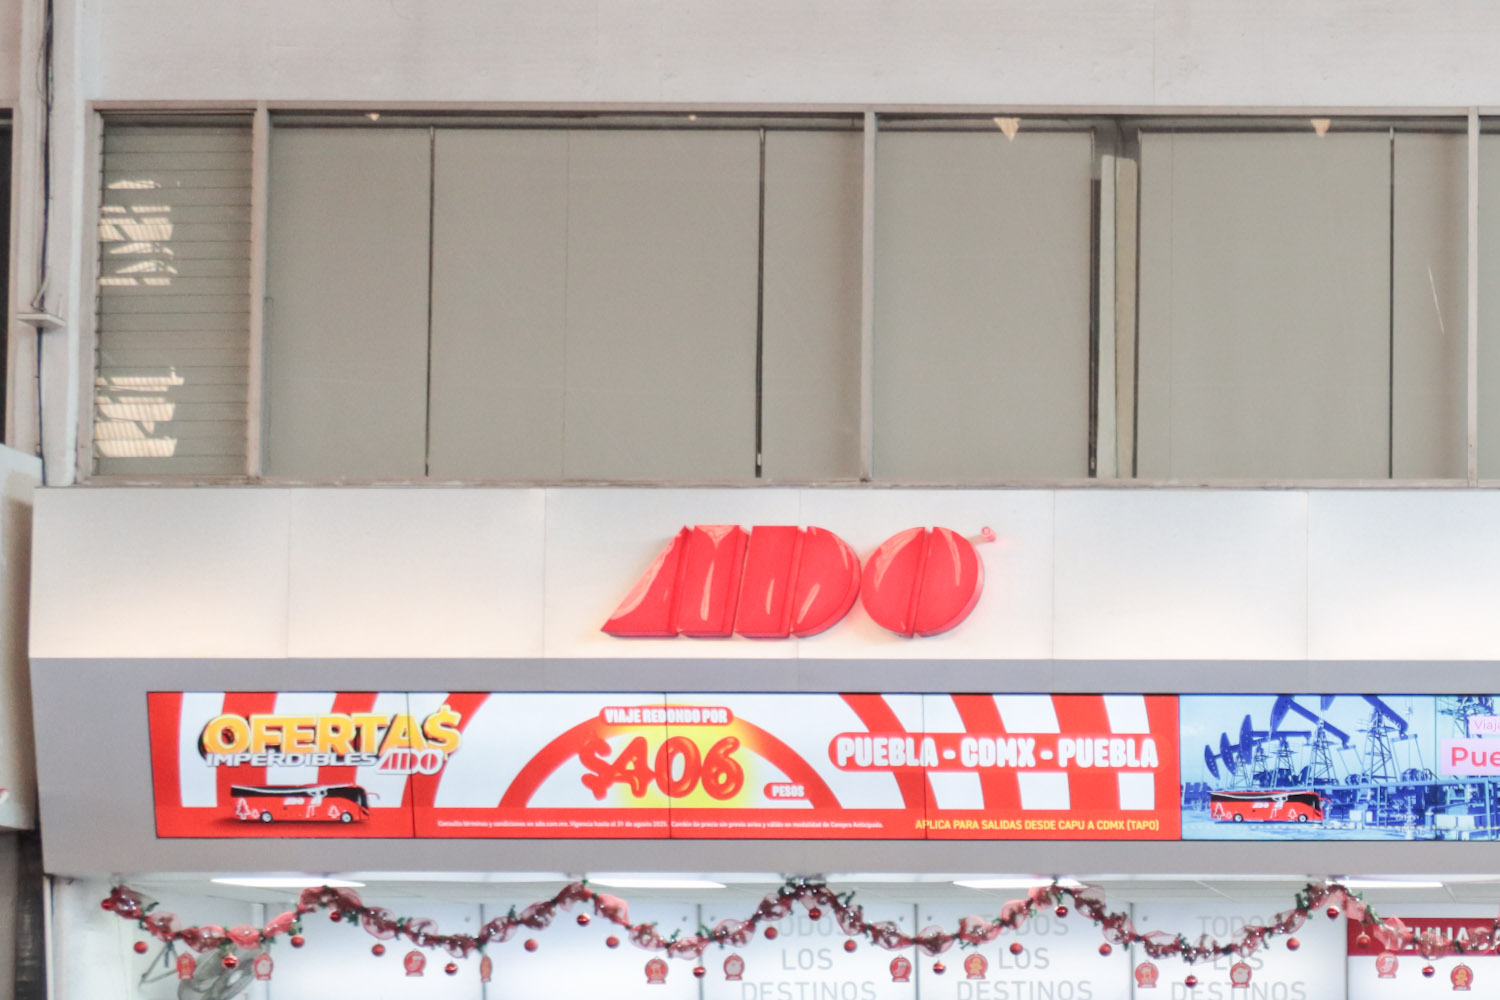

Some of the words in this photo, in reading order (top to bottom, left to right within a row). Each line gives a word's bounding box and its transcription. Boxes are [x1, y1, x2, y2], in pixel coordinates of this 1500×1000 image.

[601, 524, 985, 639] ADO
[605, 708, 641, 724] VIAJE
[642, 708, 701, 724] REDONDO
[702, 708, 728, 724] POR
[206, 752, 377, 767] IMPERDIBLES
[837, 737, 939, 768] PUEBLA
[960, 737, 1036, 768] CDMX
[1058, 738, 1159, 768] PUEBLA
[578, 732, 745, 801] $406
[772, 785, 805, 798] PESOS
[915, 820, 951, 830] APLICA
[954, 820, 979, 830] PARA
[982, 820, 1022, 830] SALIDAS
[1024, 820, 1056, 830] DESDE
[1058, 820, 1085, 830] CAPU
[1087, 820, 1095, 830] A
[1096, 820, 1125, 830] CDMX
[1126, 820, 1159, 831] (TAPO)
[781, 949, 833, 970] LOS
[999, 948, 1049, 969] LOS
